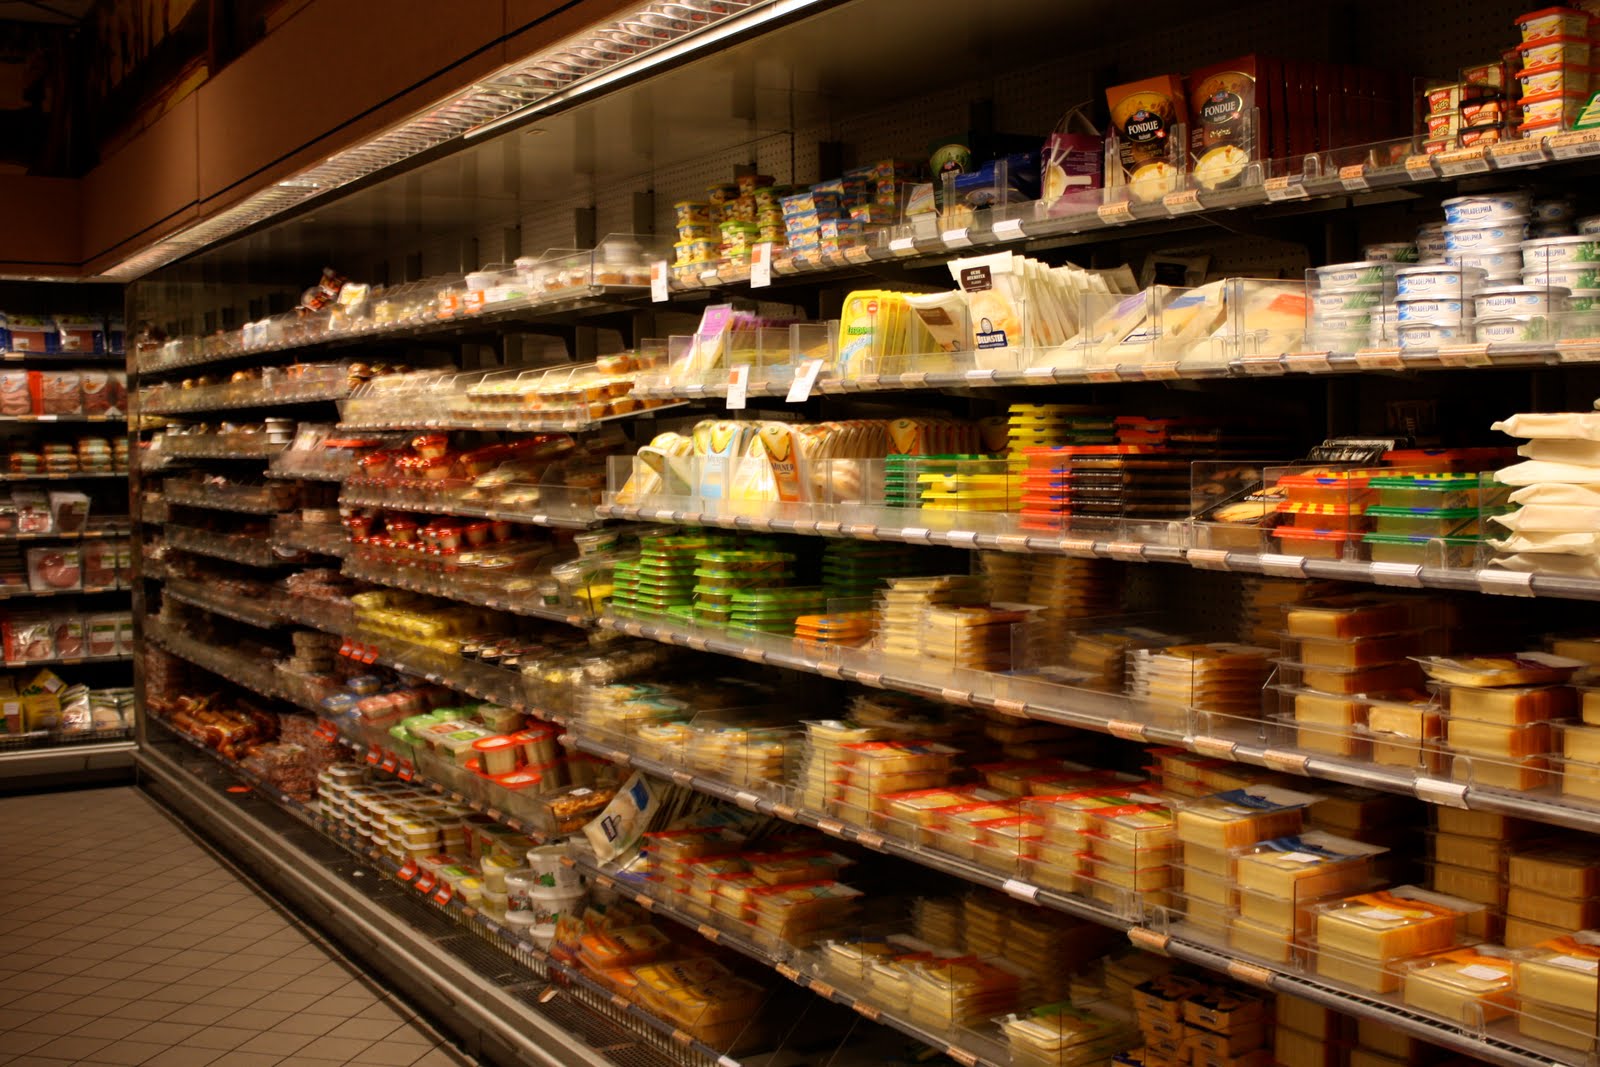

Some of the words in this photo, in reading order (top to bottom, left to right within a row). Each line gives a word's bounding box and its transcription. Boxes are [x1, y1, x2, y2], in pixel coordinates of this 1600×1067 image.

[1204, 101, 1236, 117] FONDUE
[1433, 99, 1449, 110] Kids
[1128, 120, 1159, 135] FONDUE
[1460, 205, 1492, 215] PHILADELPHIA
[1454, 233, 1482, 242] PHILADELPHIA
[1534, 248, 1566, 258] PHILADELPHIA
[1407, 277, 1436, 286] PHILADELPHIA
[1535, 276, 1567, 285] PHILADELPHIA
[1486, 297, 1517, 306] PHILADELPHIA
[1408, 304, 1439, 313] PHILADELPHIA
[1404, 331, 1431, 340] PHILADELPHIA
[1485, 327, 1515, 336] PHILADELPHIA
[977, 333, 1004, 344] BEEMSTER
[772, 463, 794, 472] MILNER
